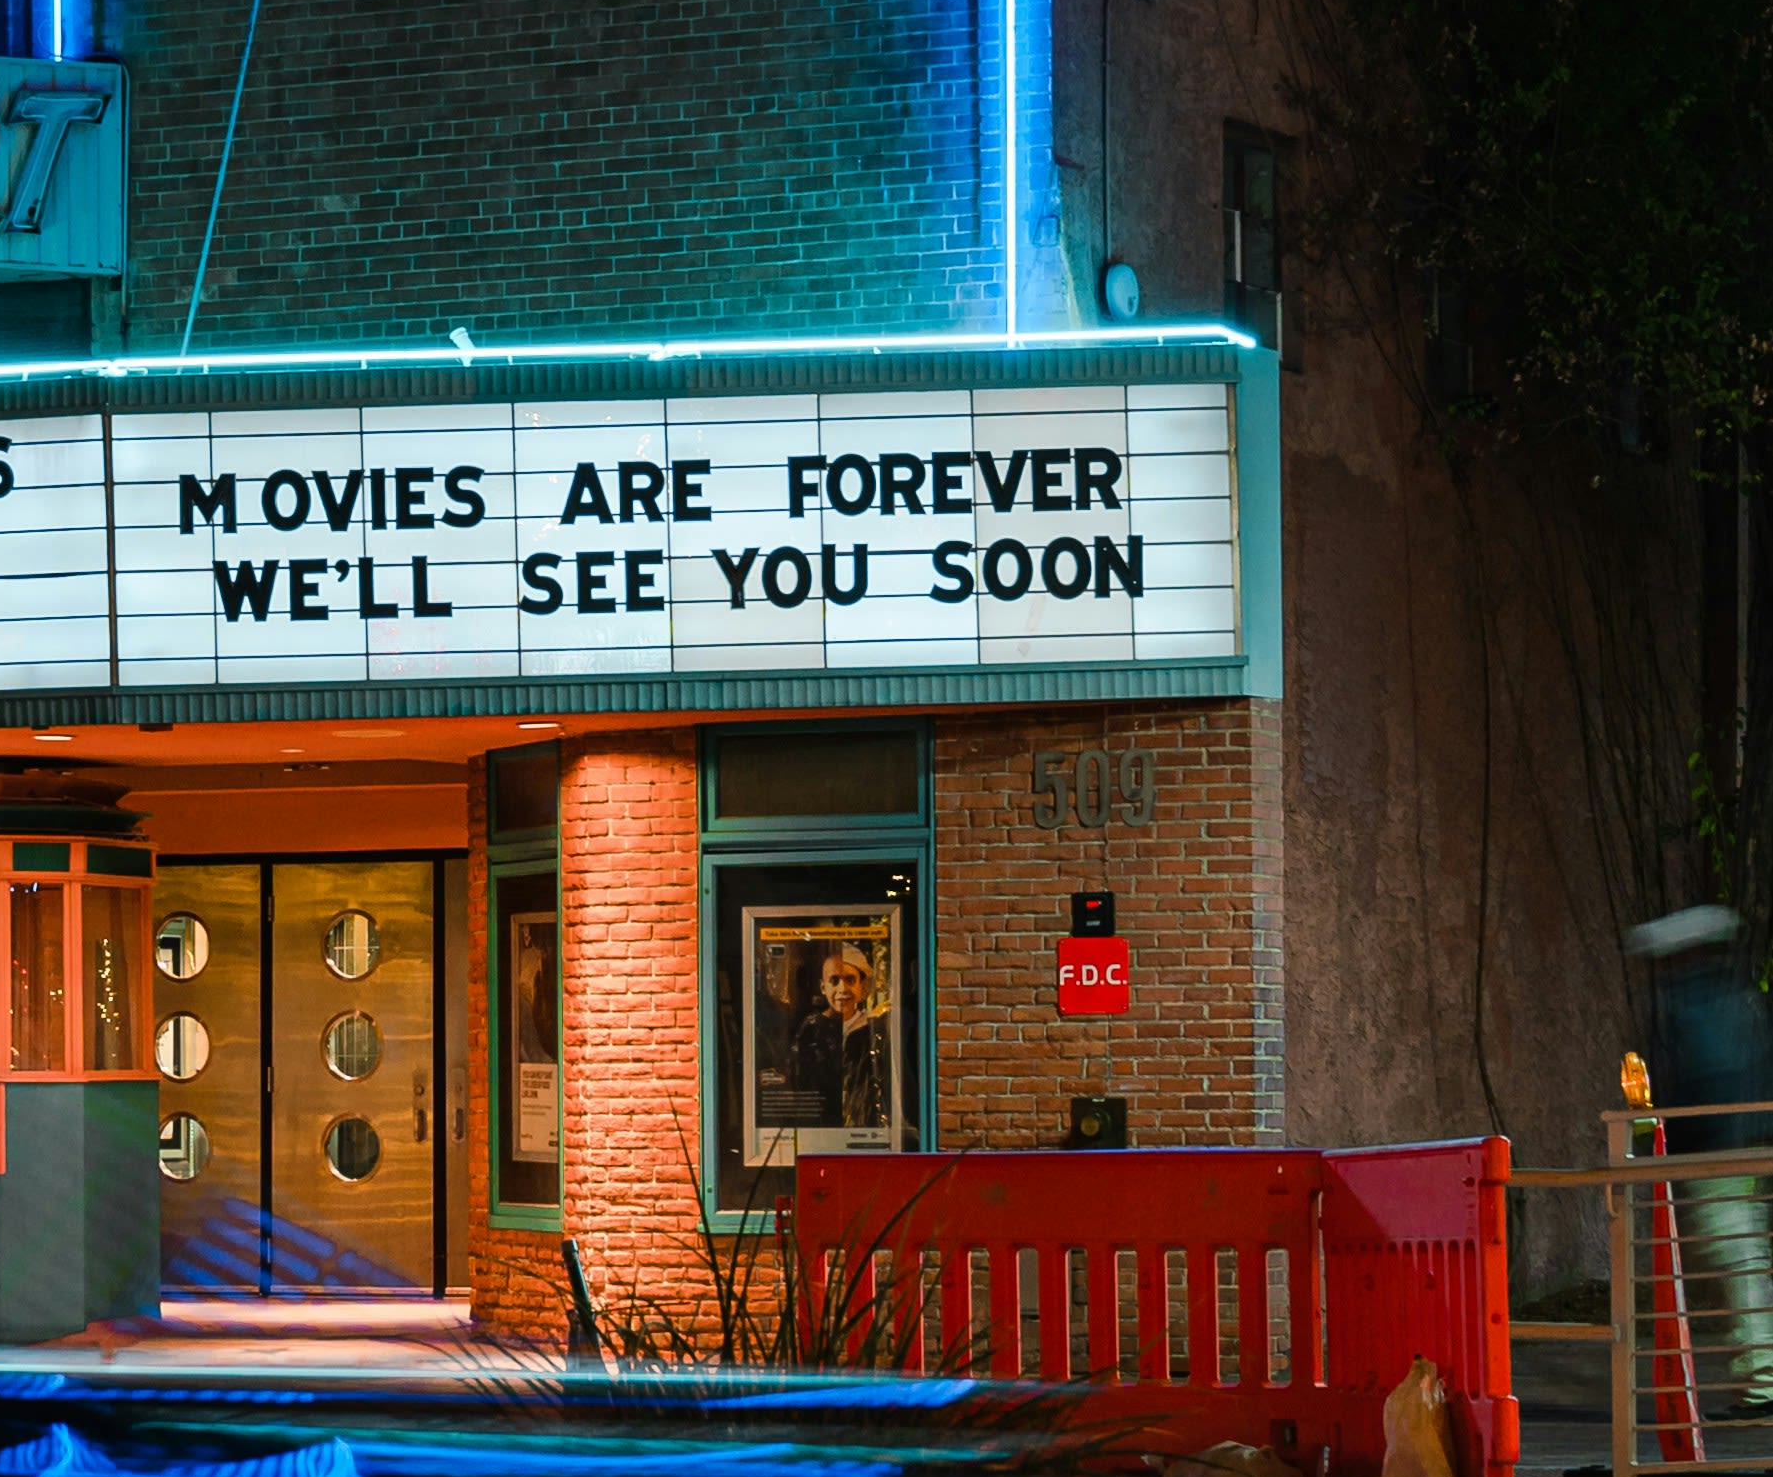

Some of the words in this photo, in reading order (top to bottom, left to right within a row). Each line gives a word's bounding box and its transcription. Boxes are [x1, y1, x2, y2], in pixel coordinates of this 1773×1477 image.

[179, 464, 486, 535] MOVIES
[560, 459, 712, 525] ARE
[787, 447, 1123, 518] FOREVER
[212, 555, 453, 623] WE'LL
[519, 549, 666, 615] SEE
[714, 543, 869, 610] YOU
[930, 535, 1144, 604] SOON
[1033, 747, 1156, 829] 509
[1059, 964, 1128, 986] F.D.C.
